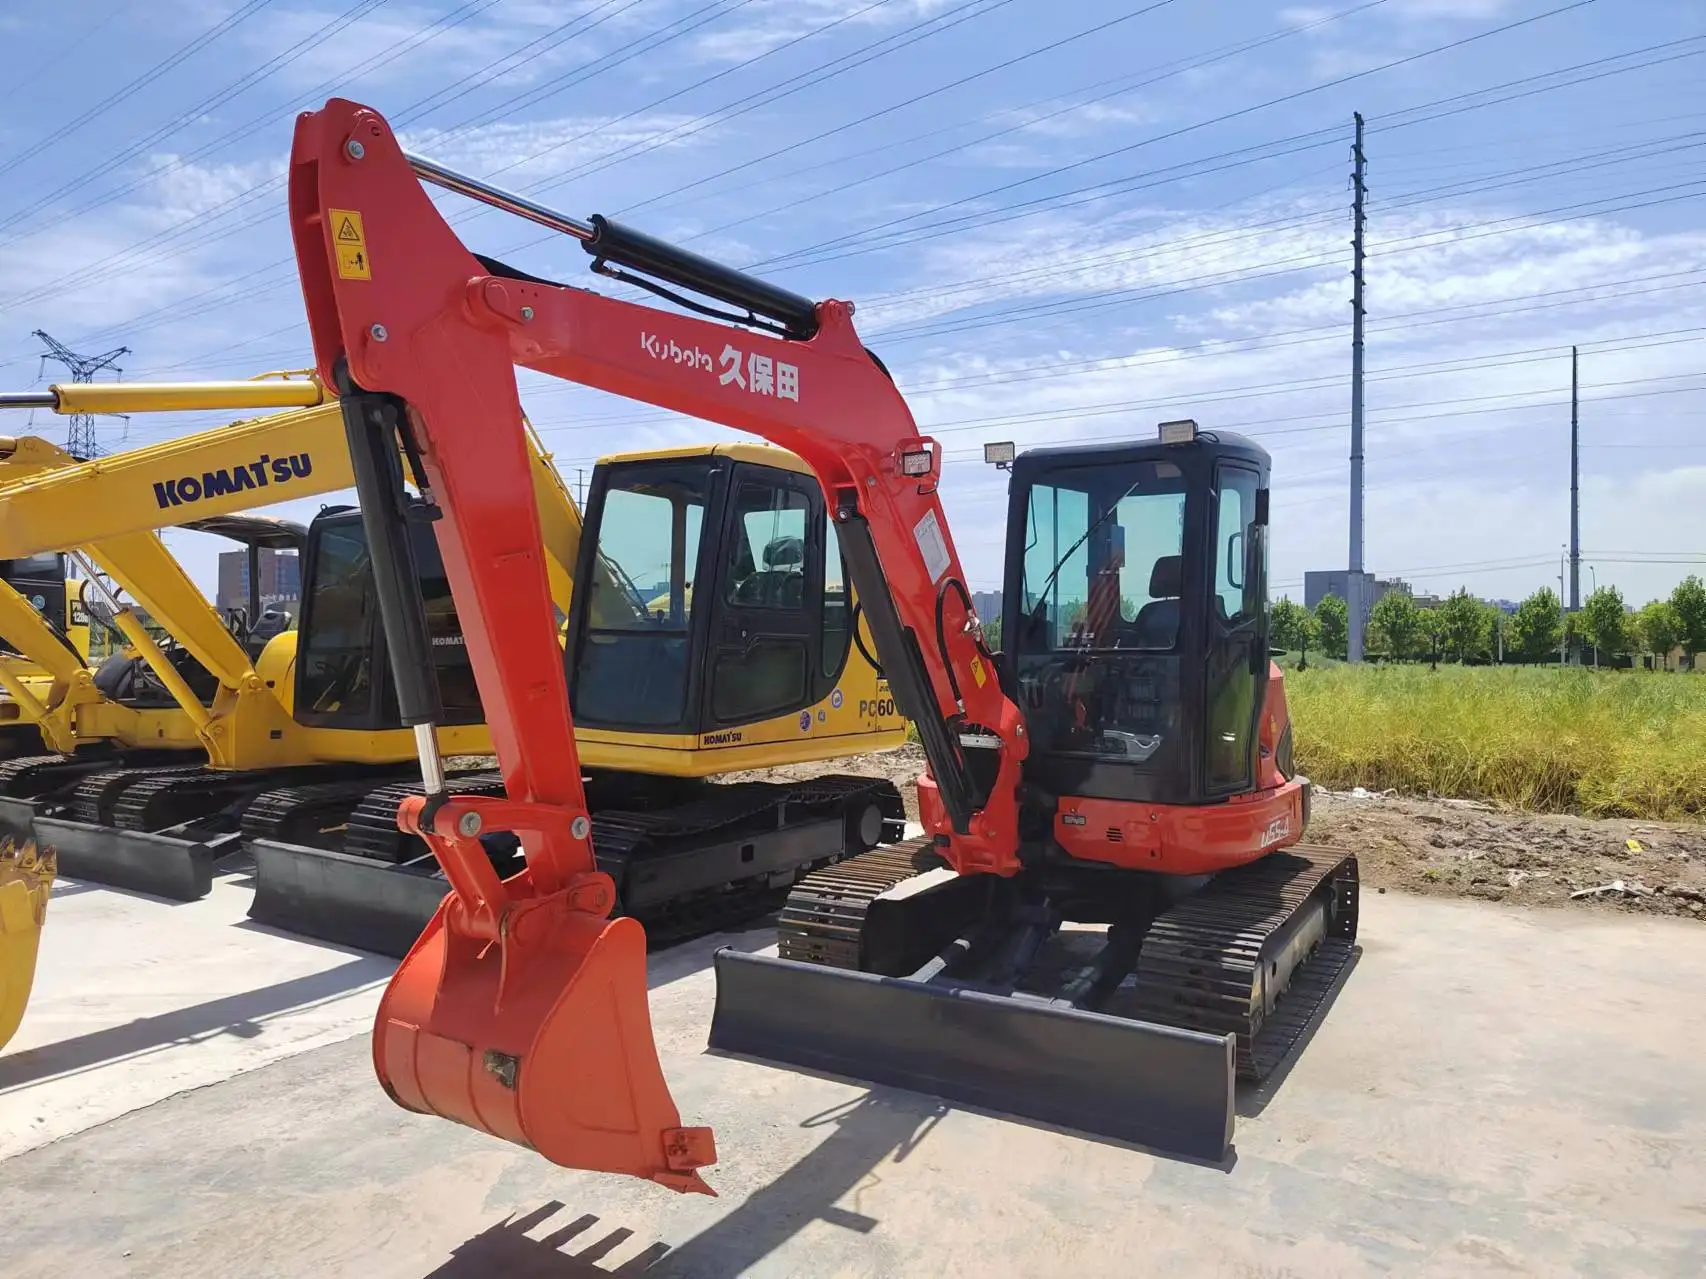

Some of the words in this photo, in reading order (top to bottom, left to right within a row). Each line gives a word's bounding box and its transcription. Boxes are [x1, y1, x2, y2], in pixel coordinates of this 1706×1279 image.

[640, 331, 713, 373] Kubota
[718, 343, 799, 403] 久保田
[152, 453, 313, 509] KOMATSU
[703, 731, 742, 746] KOMATSU
